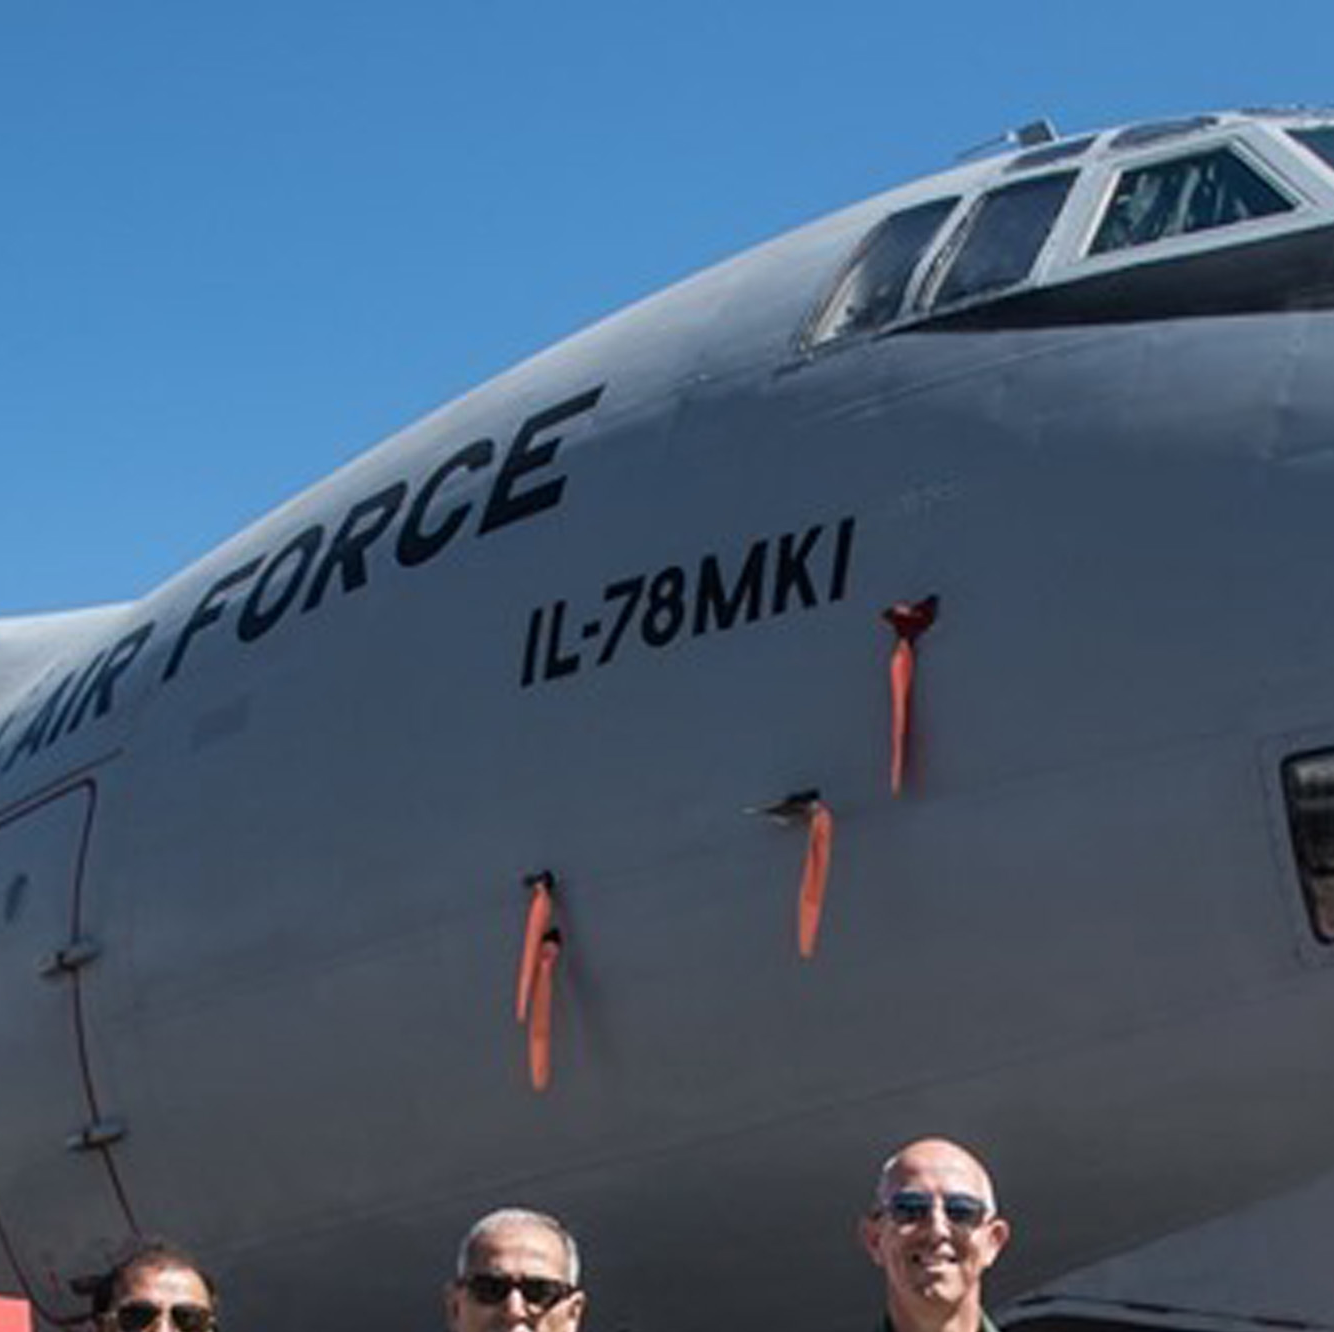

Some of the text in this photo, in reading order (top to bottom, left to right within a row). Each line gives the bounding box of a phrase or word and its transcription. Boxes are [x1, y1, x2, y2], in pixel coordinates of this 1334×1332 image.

[3, 621, 155, 772] AIR
[163, 385, 605, 682] FORCE
[520, 517, 855, 687] IL-78MKI
